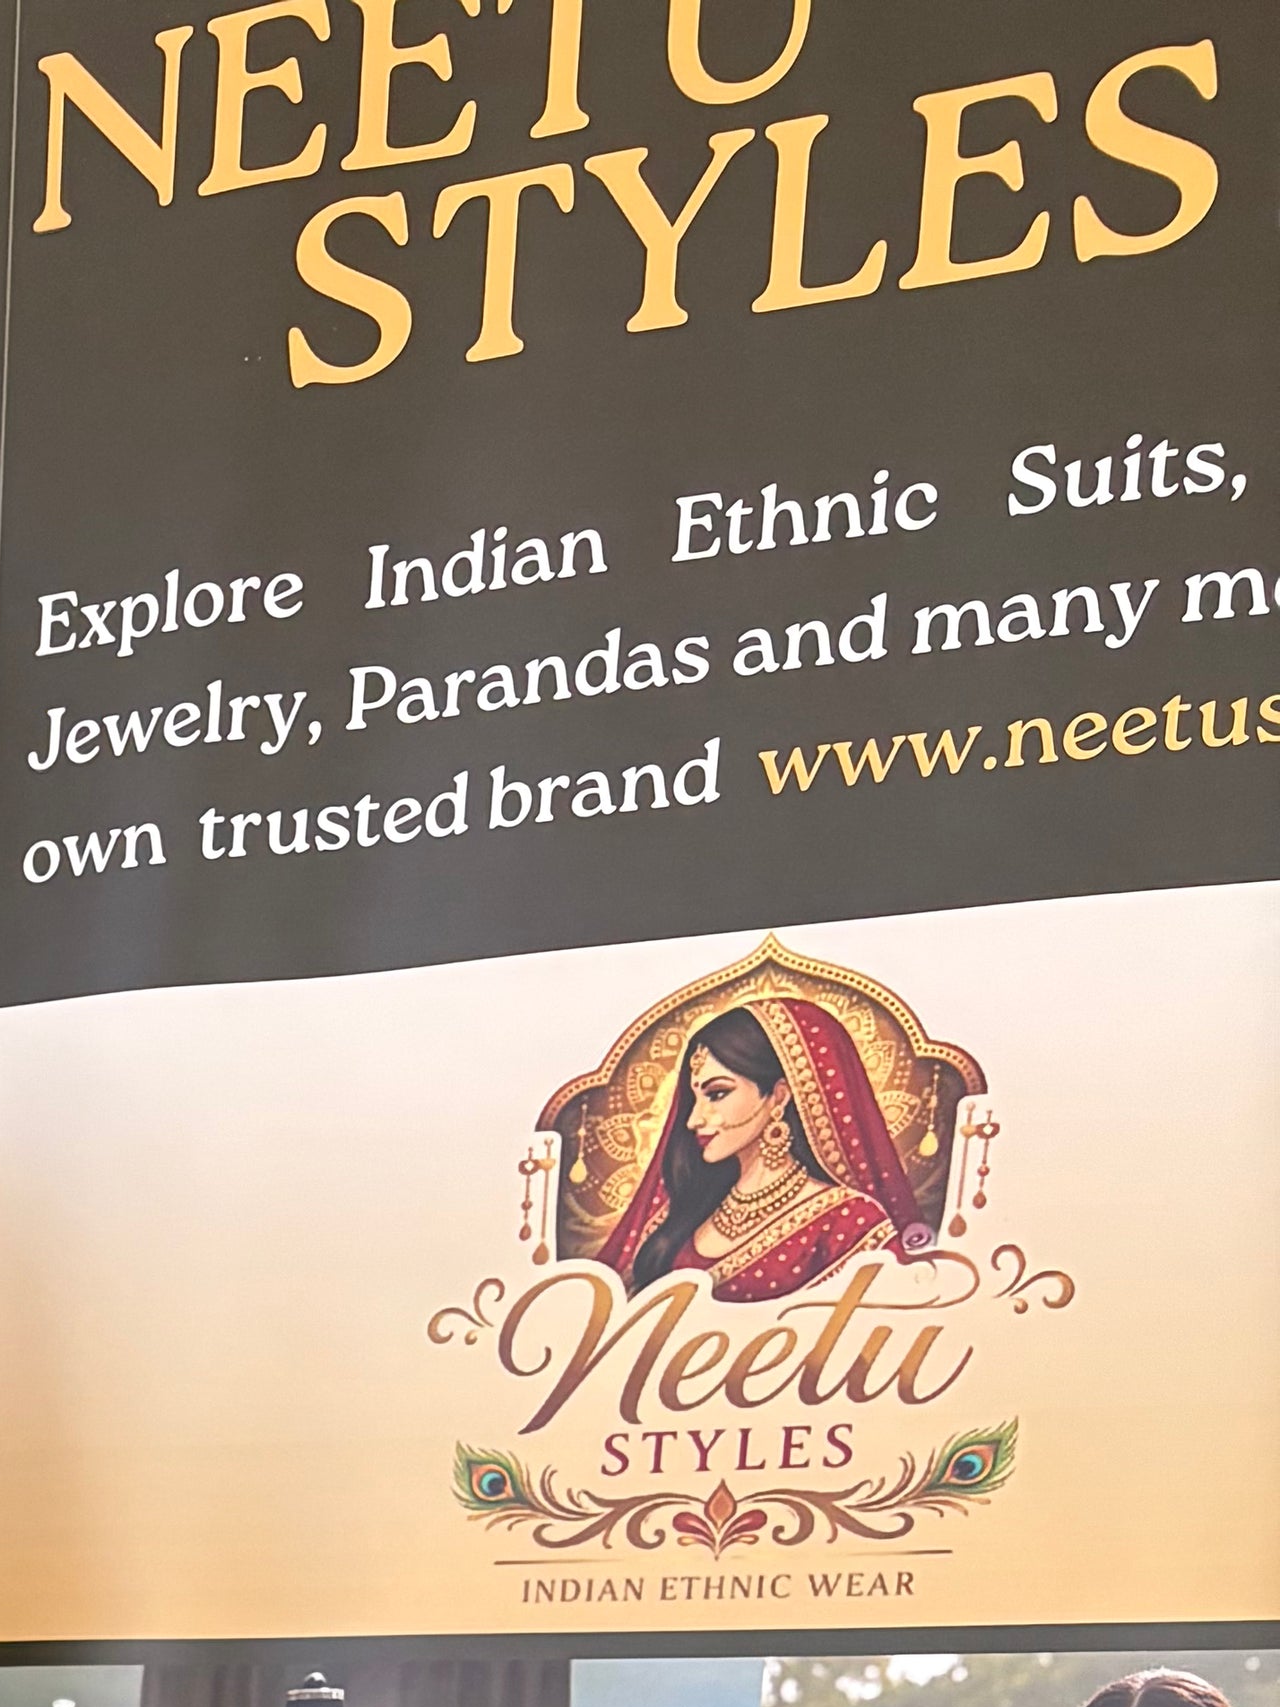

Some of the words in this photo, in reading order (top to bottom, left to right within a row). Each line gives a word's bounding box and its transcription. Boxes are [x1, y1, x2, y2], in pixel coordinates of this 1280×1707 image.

[33, 0, 811, 233] NEETU
[288, 39, 1218, 388] STYLES
[35, 569, 303, 659] Explore
[365, 526, 607, 609] Indian
[672, 470, 937, 562] Ethnic
[1009, 434, 1246, 517] Suits,
[28, 680, 321, 770] Jewelry,
[346, 628, 709, 730] Parandas
[733, 593, 887, 675] and
[912, 579, 1160, 654] many
[1182, 568, 1280, 622] m
[23, 813, 166, 883] own
[199, 771, 468, 859] trusted
[489, 737, 720, 829] brand
[759, 695, 1280, 794] www.neetus
[498, 1262, 980, 1435] Neetu
[601, 1423, 856, 1477] STYLES
[522, 1576, 643, 1604] INDIAN
[660, 1573, 793, 1601] ETHNIC
[808, 1570, 916, 1598] WEAR
